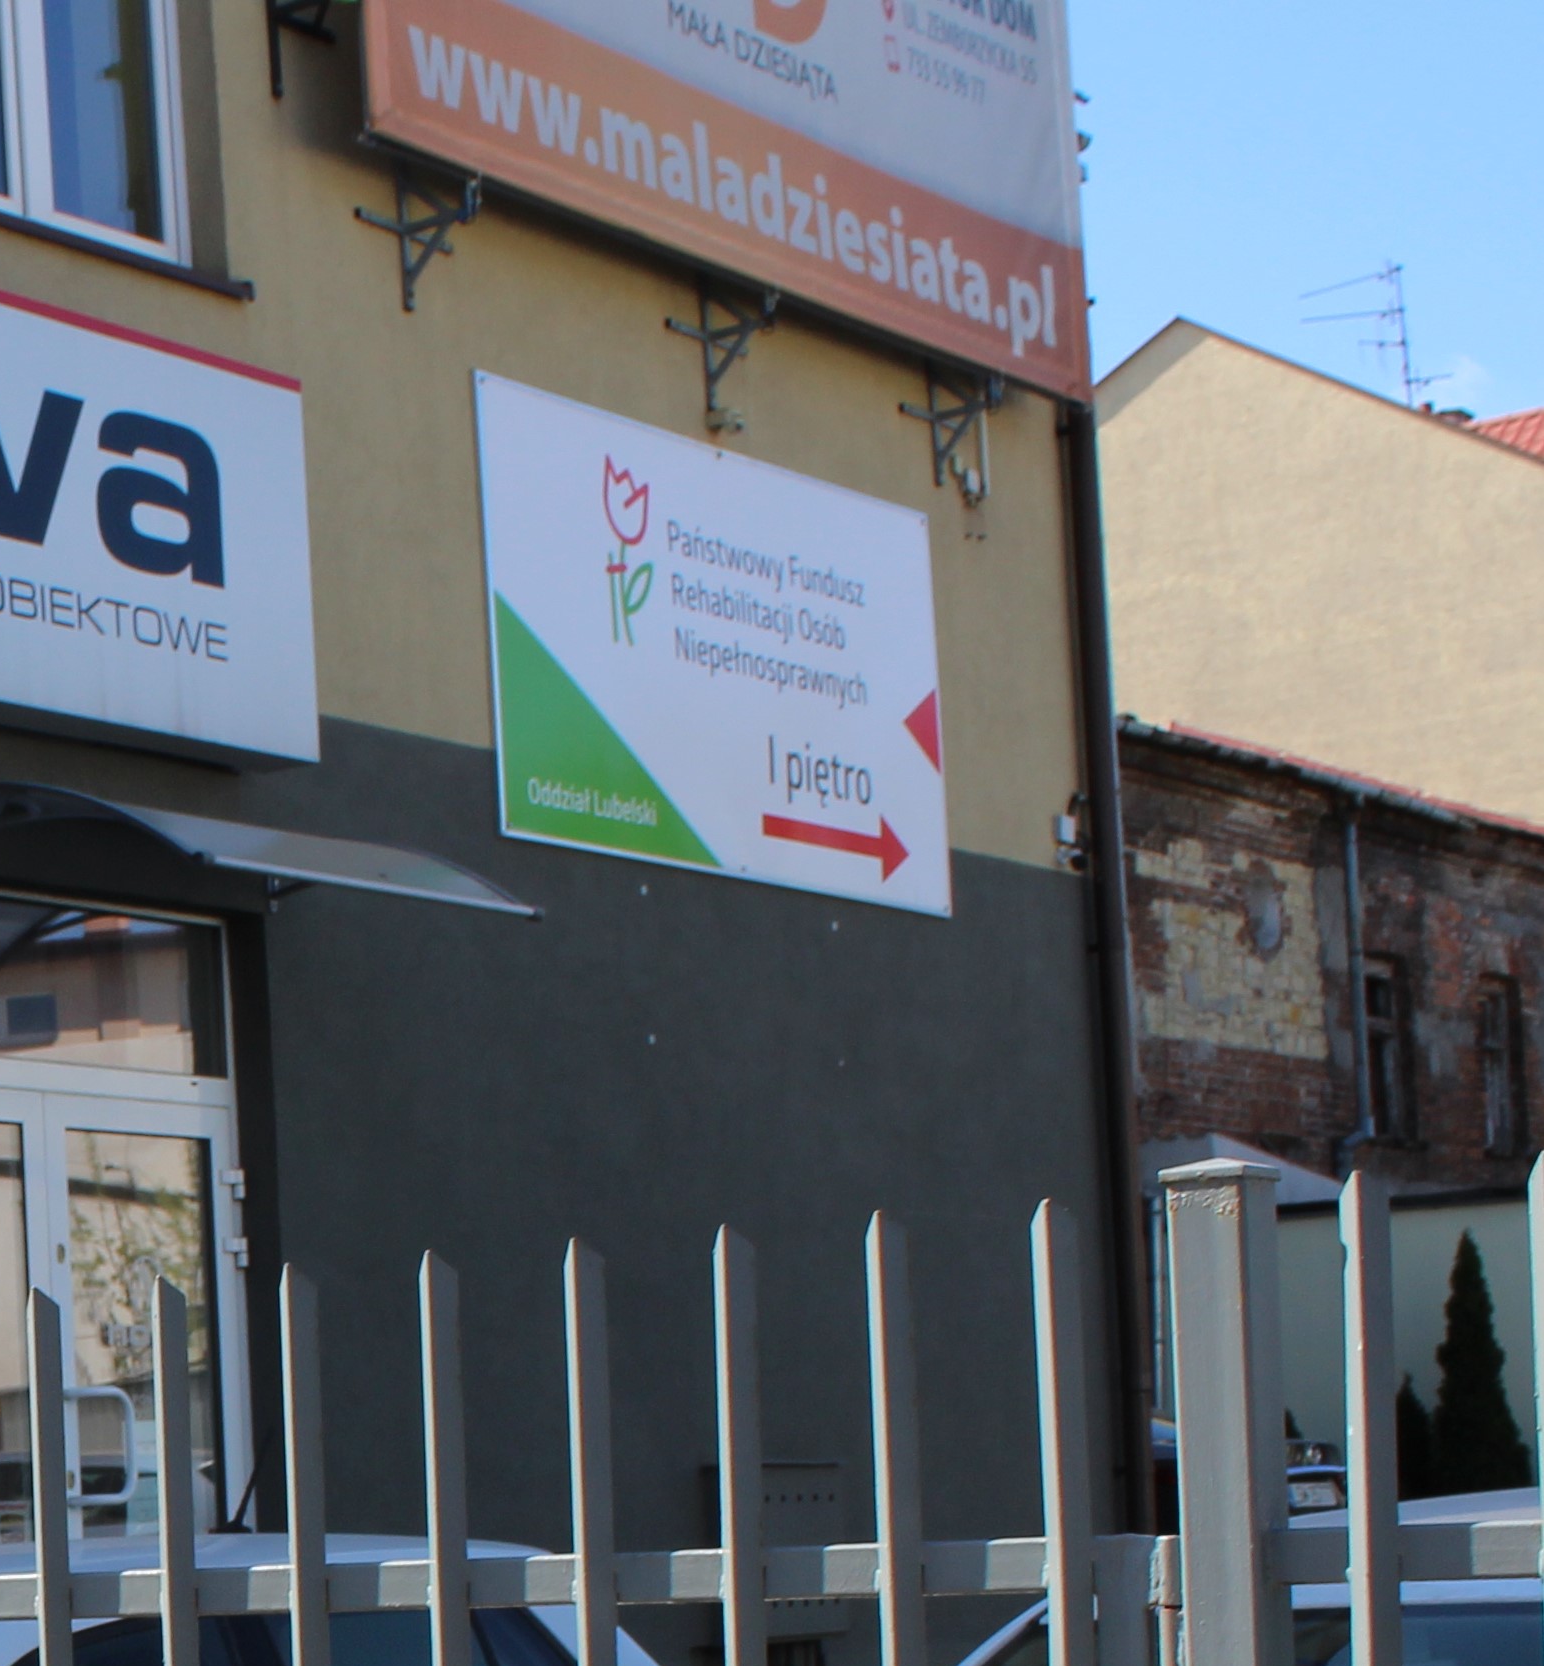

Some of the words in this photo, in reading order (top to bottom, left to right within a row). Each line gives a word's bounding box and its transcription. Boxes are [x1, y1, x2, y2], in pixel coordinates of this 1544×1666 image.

[408, 24, 1057, 357] www.maladziesiata.pl
[667, 519, 784, 593] Państwowy
[788, 555, 866, 607] Fundusz
[671, 571, 793, 645] Rehabilitacji
[798, 607, 847, 650] Osób
[674, 625, 868, 710] Niepełnosprawnych
[527, 776, 591, 815] Oddział
[593, 788, 658, 827] Lubelski
[768, 734, 776, 784] I
[786, 742, 873, 808] piętro
